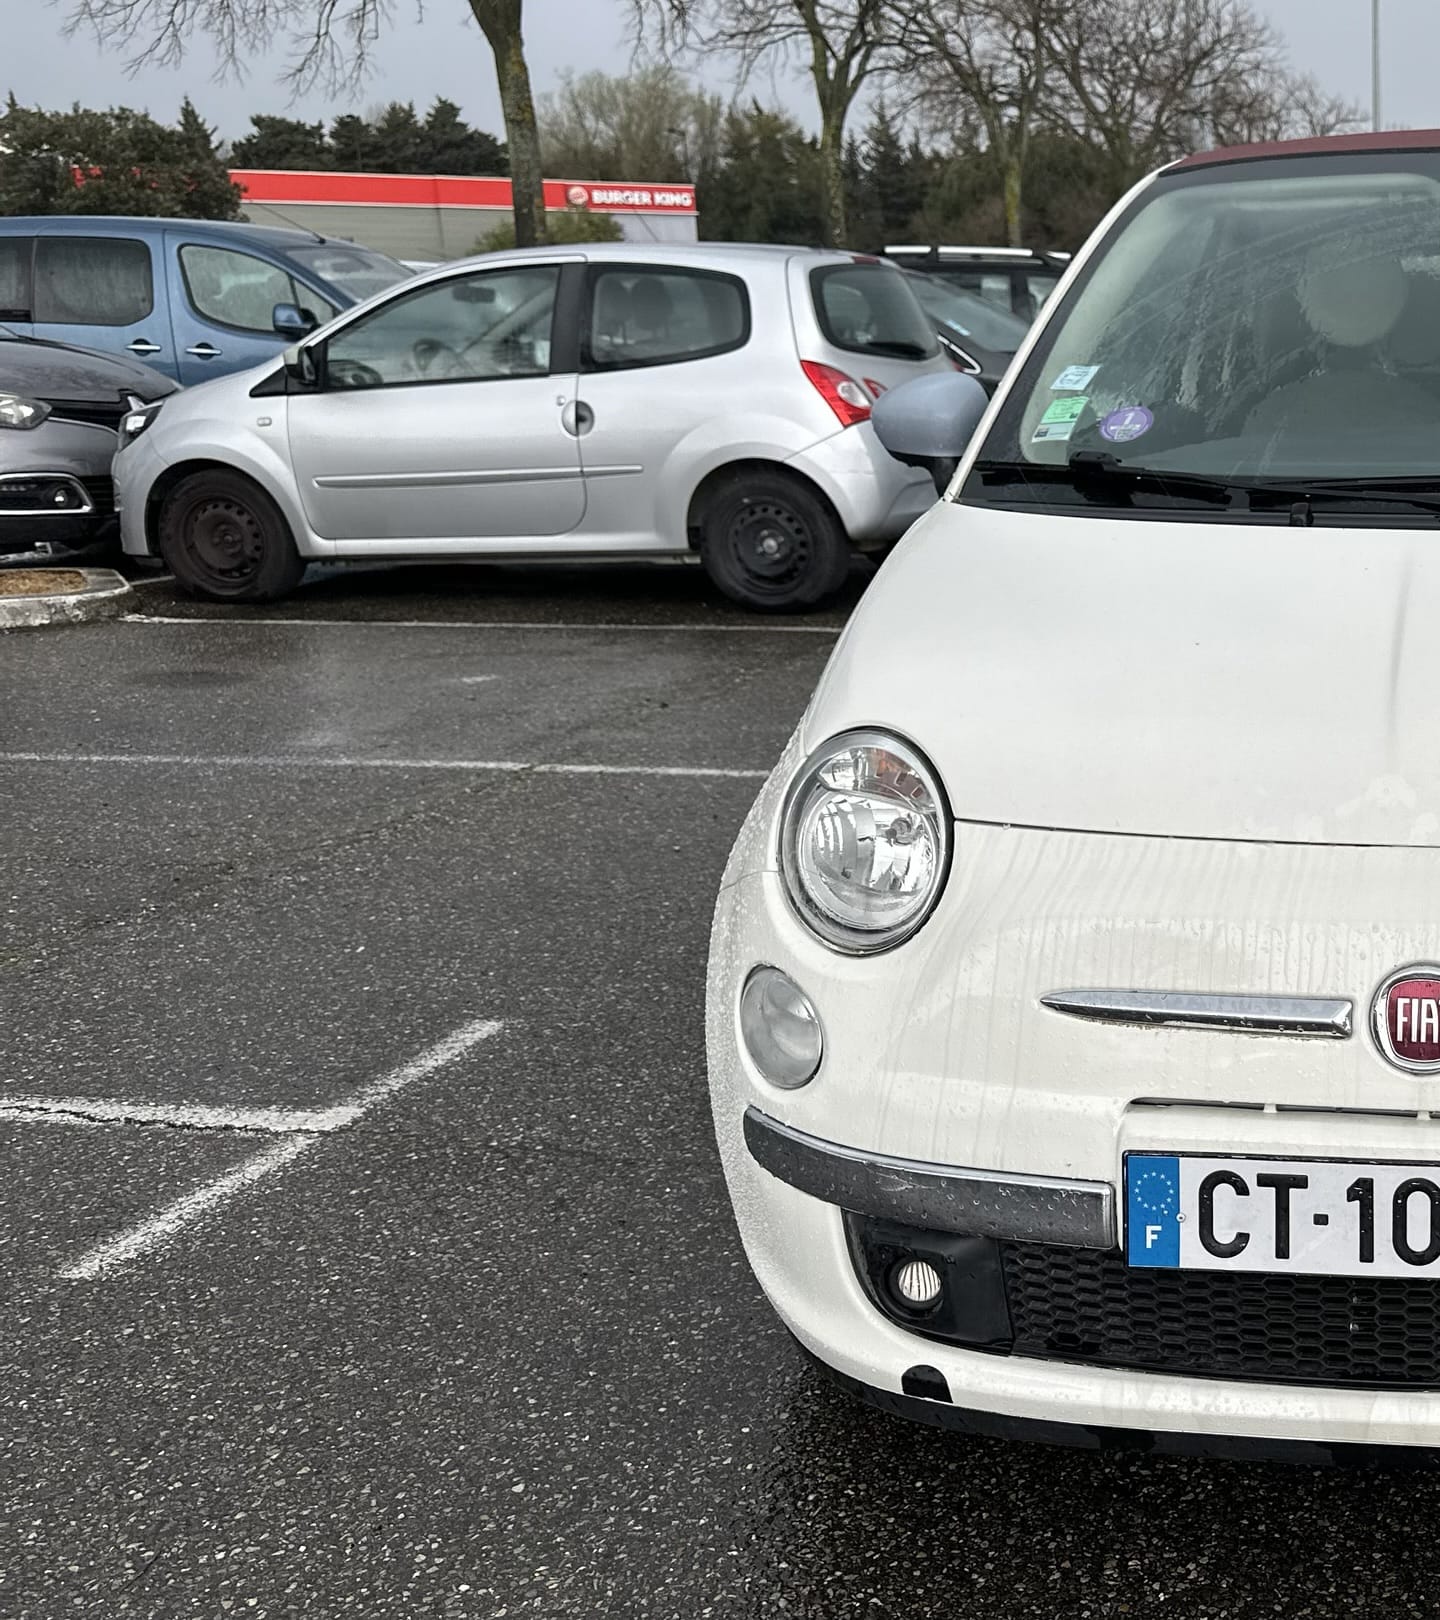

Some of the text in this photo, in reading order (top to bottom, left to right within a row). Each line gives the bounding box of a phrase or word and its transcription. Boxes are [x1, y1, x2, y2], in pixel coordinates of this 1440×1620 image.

[591, 189, 651, 206] BURGER
[653, 191, 693, 207] KING
[1145, 1225, 1163, 1250] F
